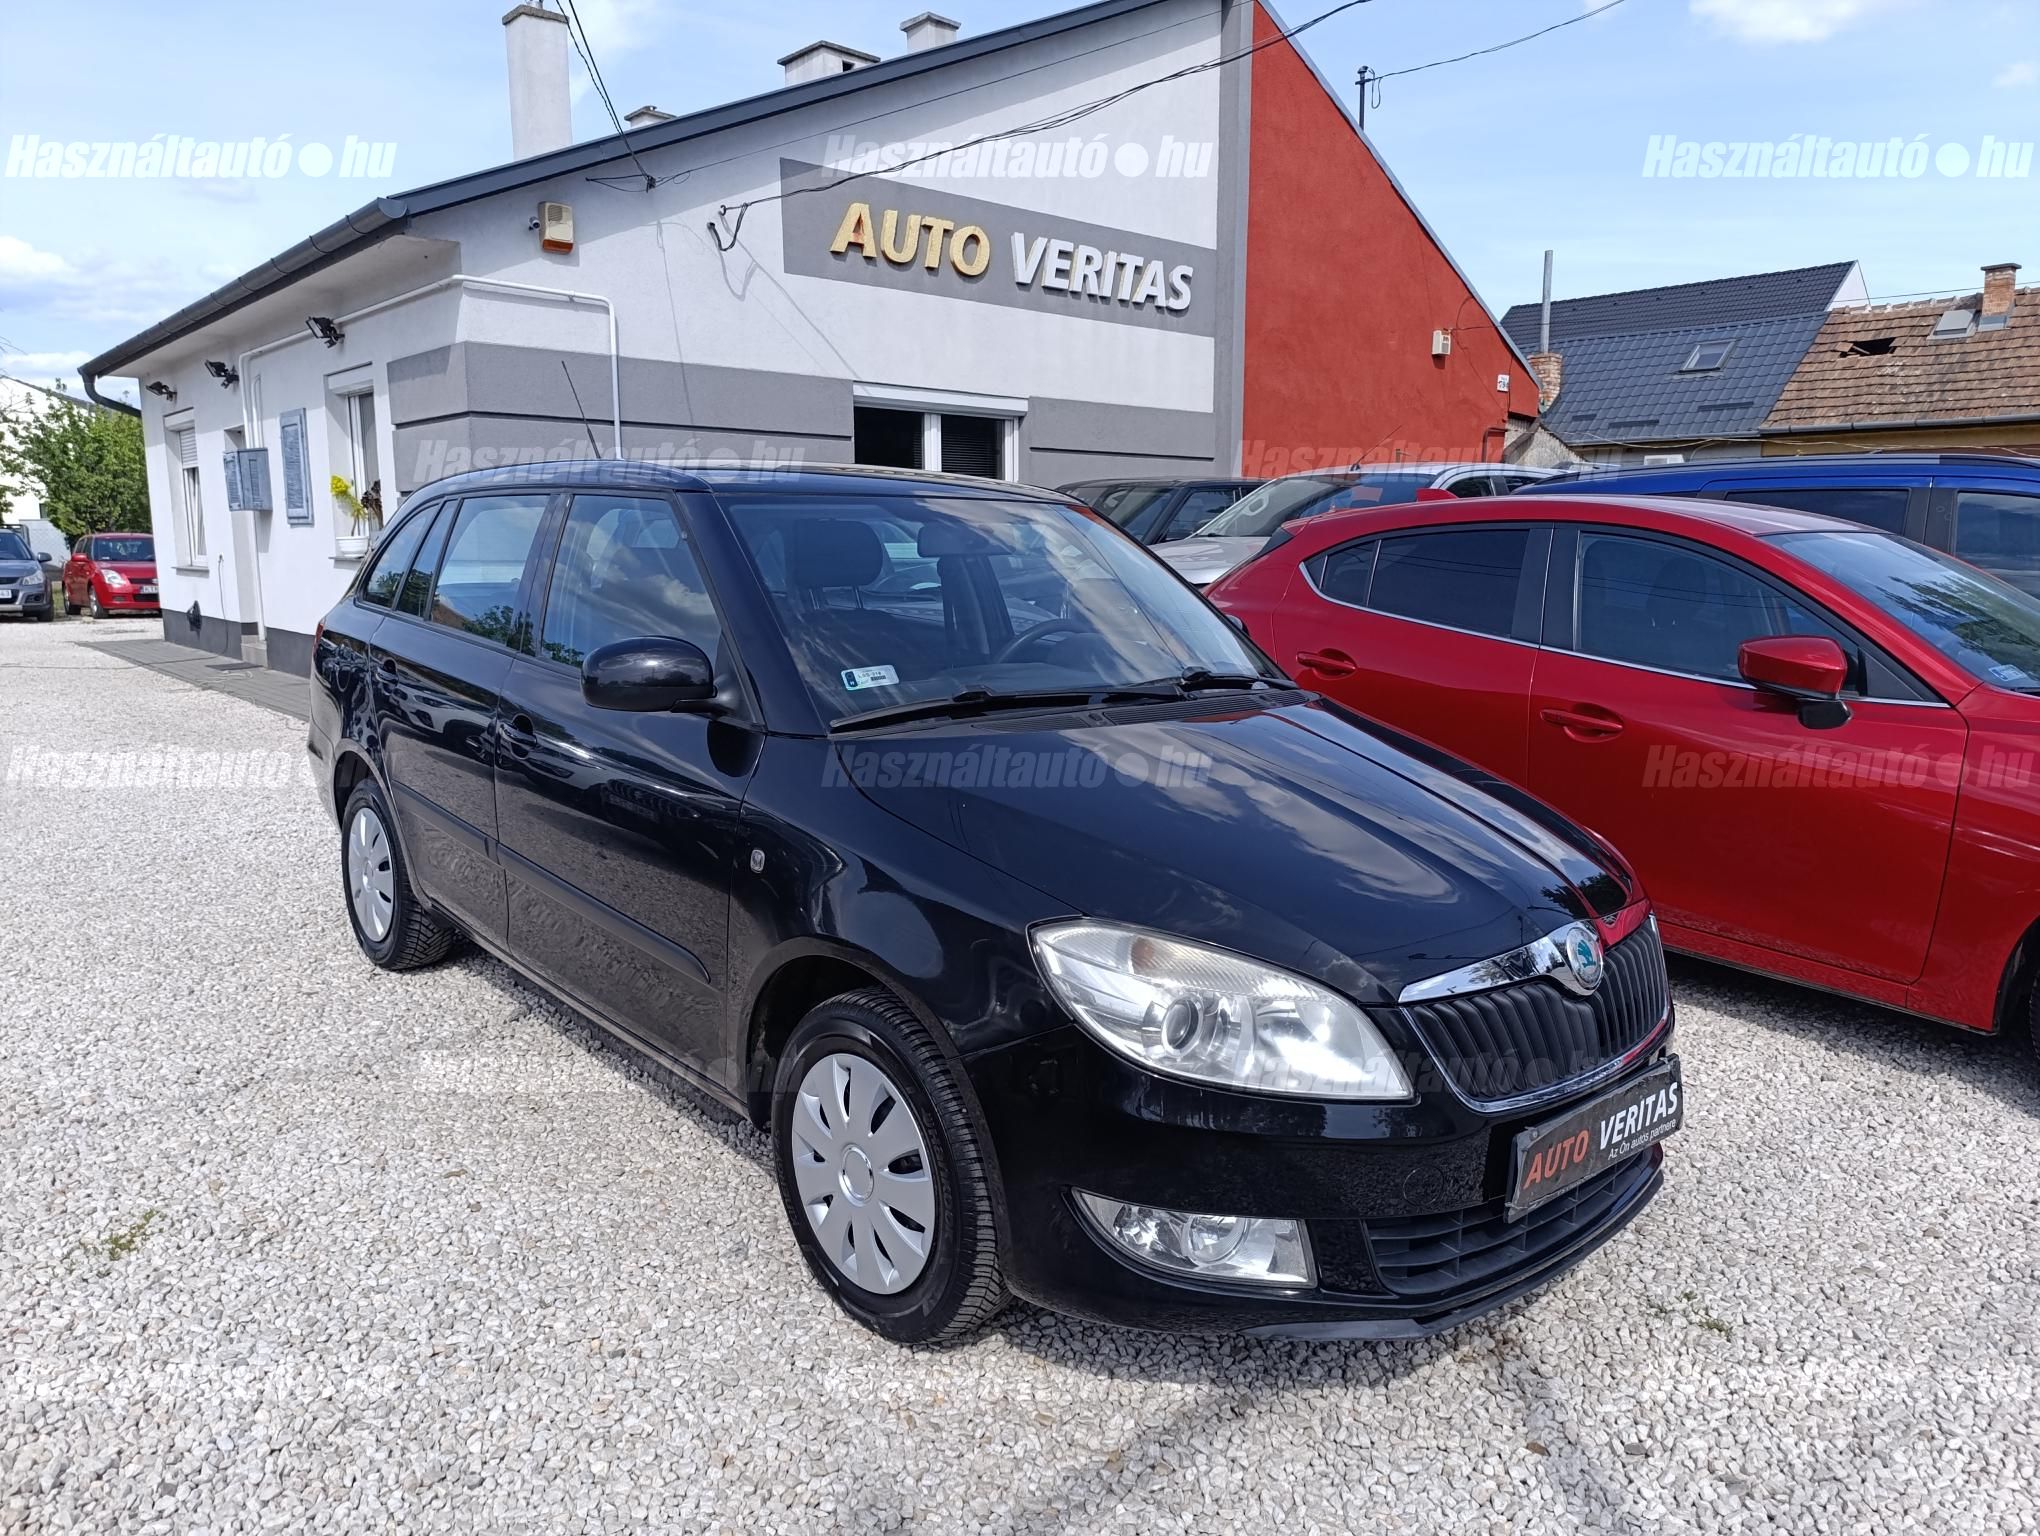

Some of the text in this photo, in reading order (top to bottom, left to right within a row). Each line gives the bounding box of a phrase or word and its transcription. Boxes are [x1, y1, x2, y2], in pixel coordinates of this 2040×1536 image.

[830, 202, 1194, 311] AUTO VERITAS
[1523, 1082, 1679, 1190] AUTO VERITAS
[1608, 1148, 1618, 1161] Az
[1650, 1118, 1677, 1142] partnere
